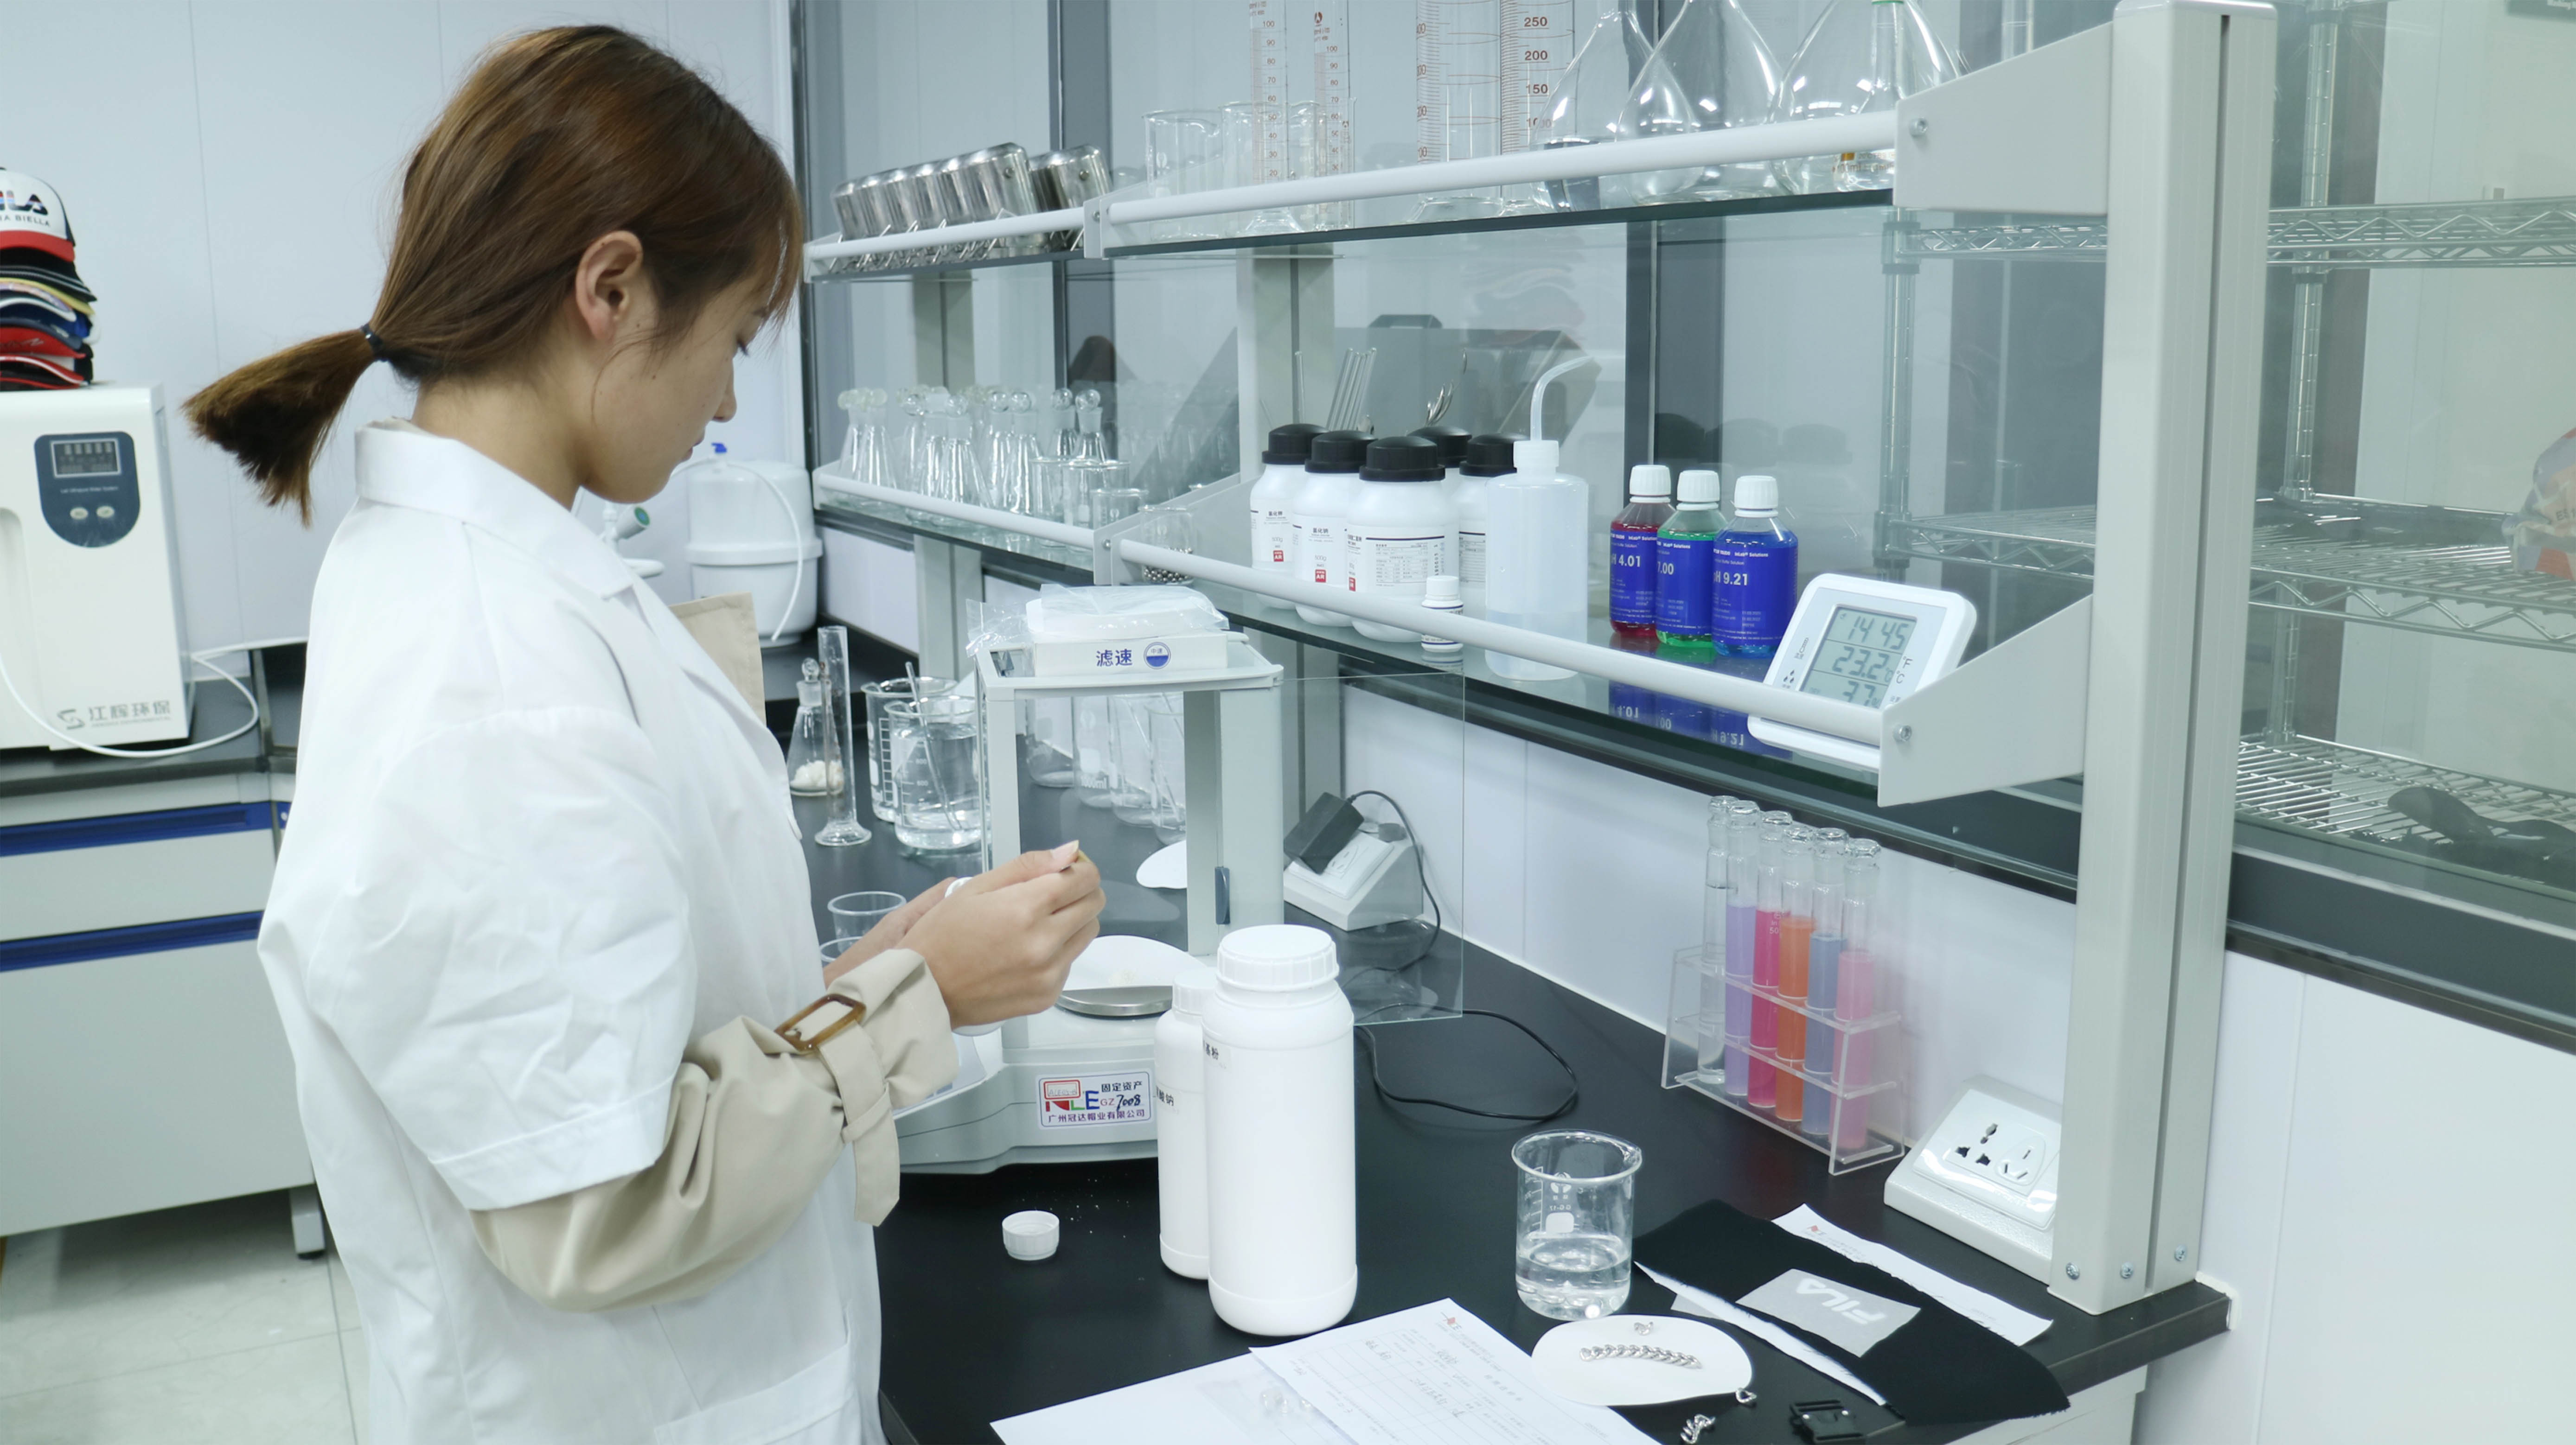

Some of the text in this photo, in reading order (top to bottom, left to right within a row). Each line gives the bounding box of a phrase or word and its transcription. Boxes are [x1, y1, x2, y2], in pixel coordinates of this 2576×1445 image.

[1524, 17, 1547, 27] 250
[1525, 50, 1548, 61] 200
[1526, 84, 1548, 94] 150
[0, 190, 48, 216] ILA
[15, 215, 51, 227] BIELLA
[1618, 554, 1641, 567] 4.01
[1657, 561, 1675, 575] 7.00
[1723, 572, 1748, 586] 9.21
[1096, 649, 1132, 667] 滤速
[1832, 645, 1890, 680] 23.2
[89, 700, 171, 721] 江辉环保
[1101, 1081, 1142, 1093] 固定资产
[1100, 1098, 1115, 1106] GZ
[1116, 1094, 1141, 1111] 7008
[1048, 1109, 1145, 1123] 广州冠达帽业有限公司
[1796, 1278, 1888, 1324] FILA
